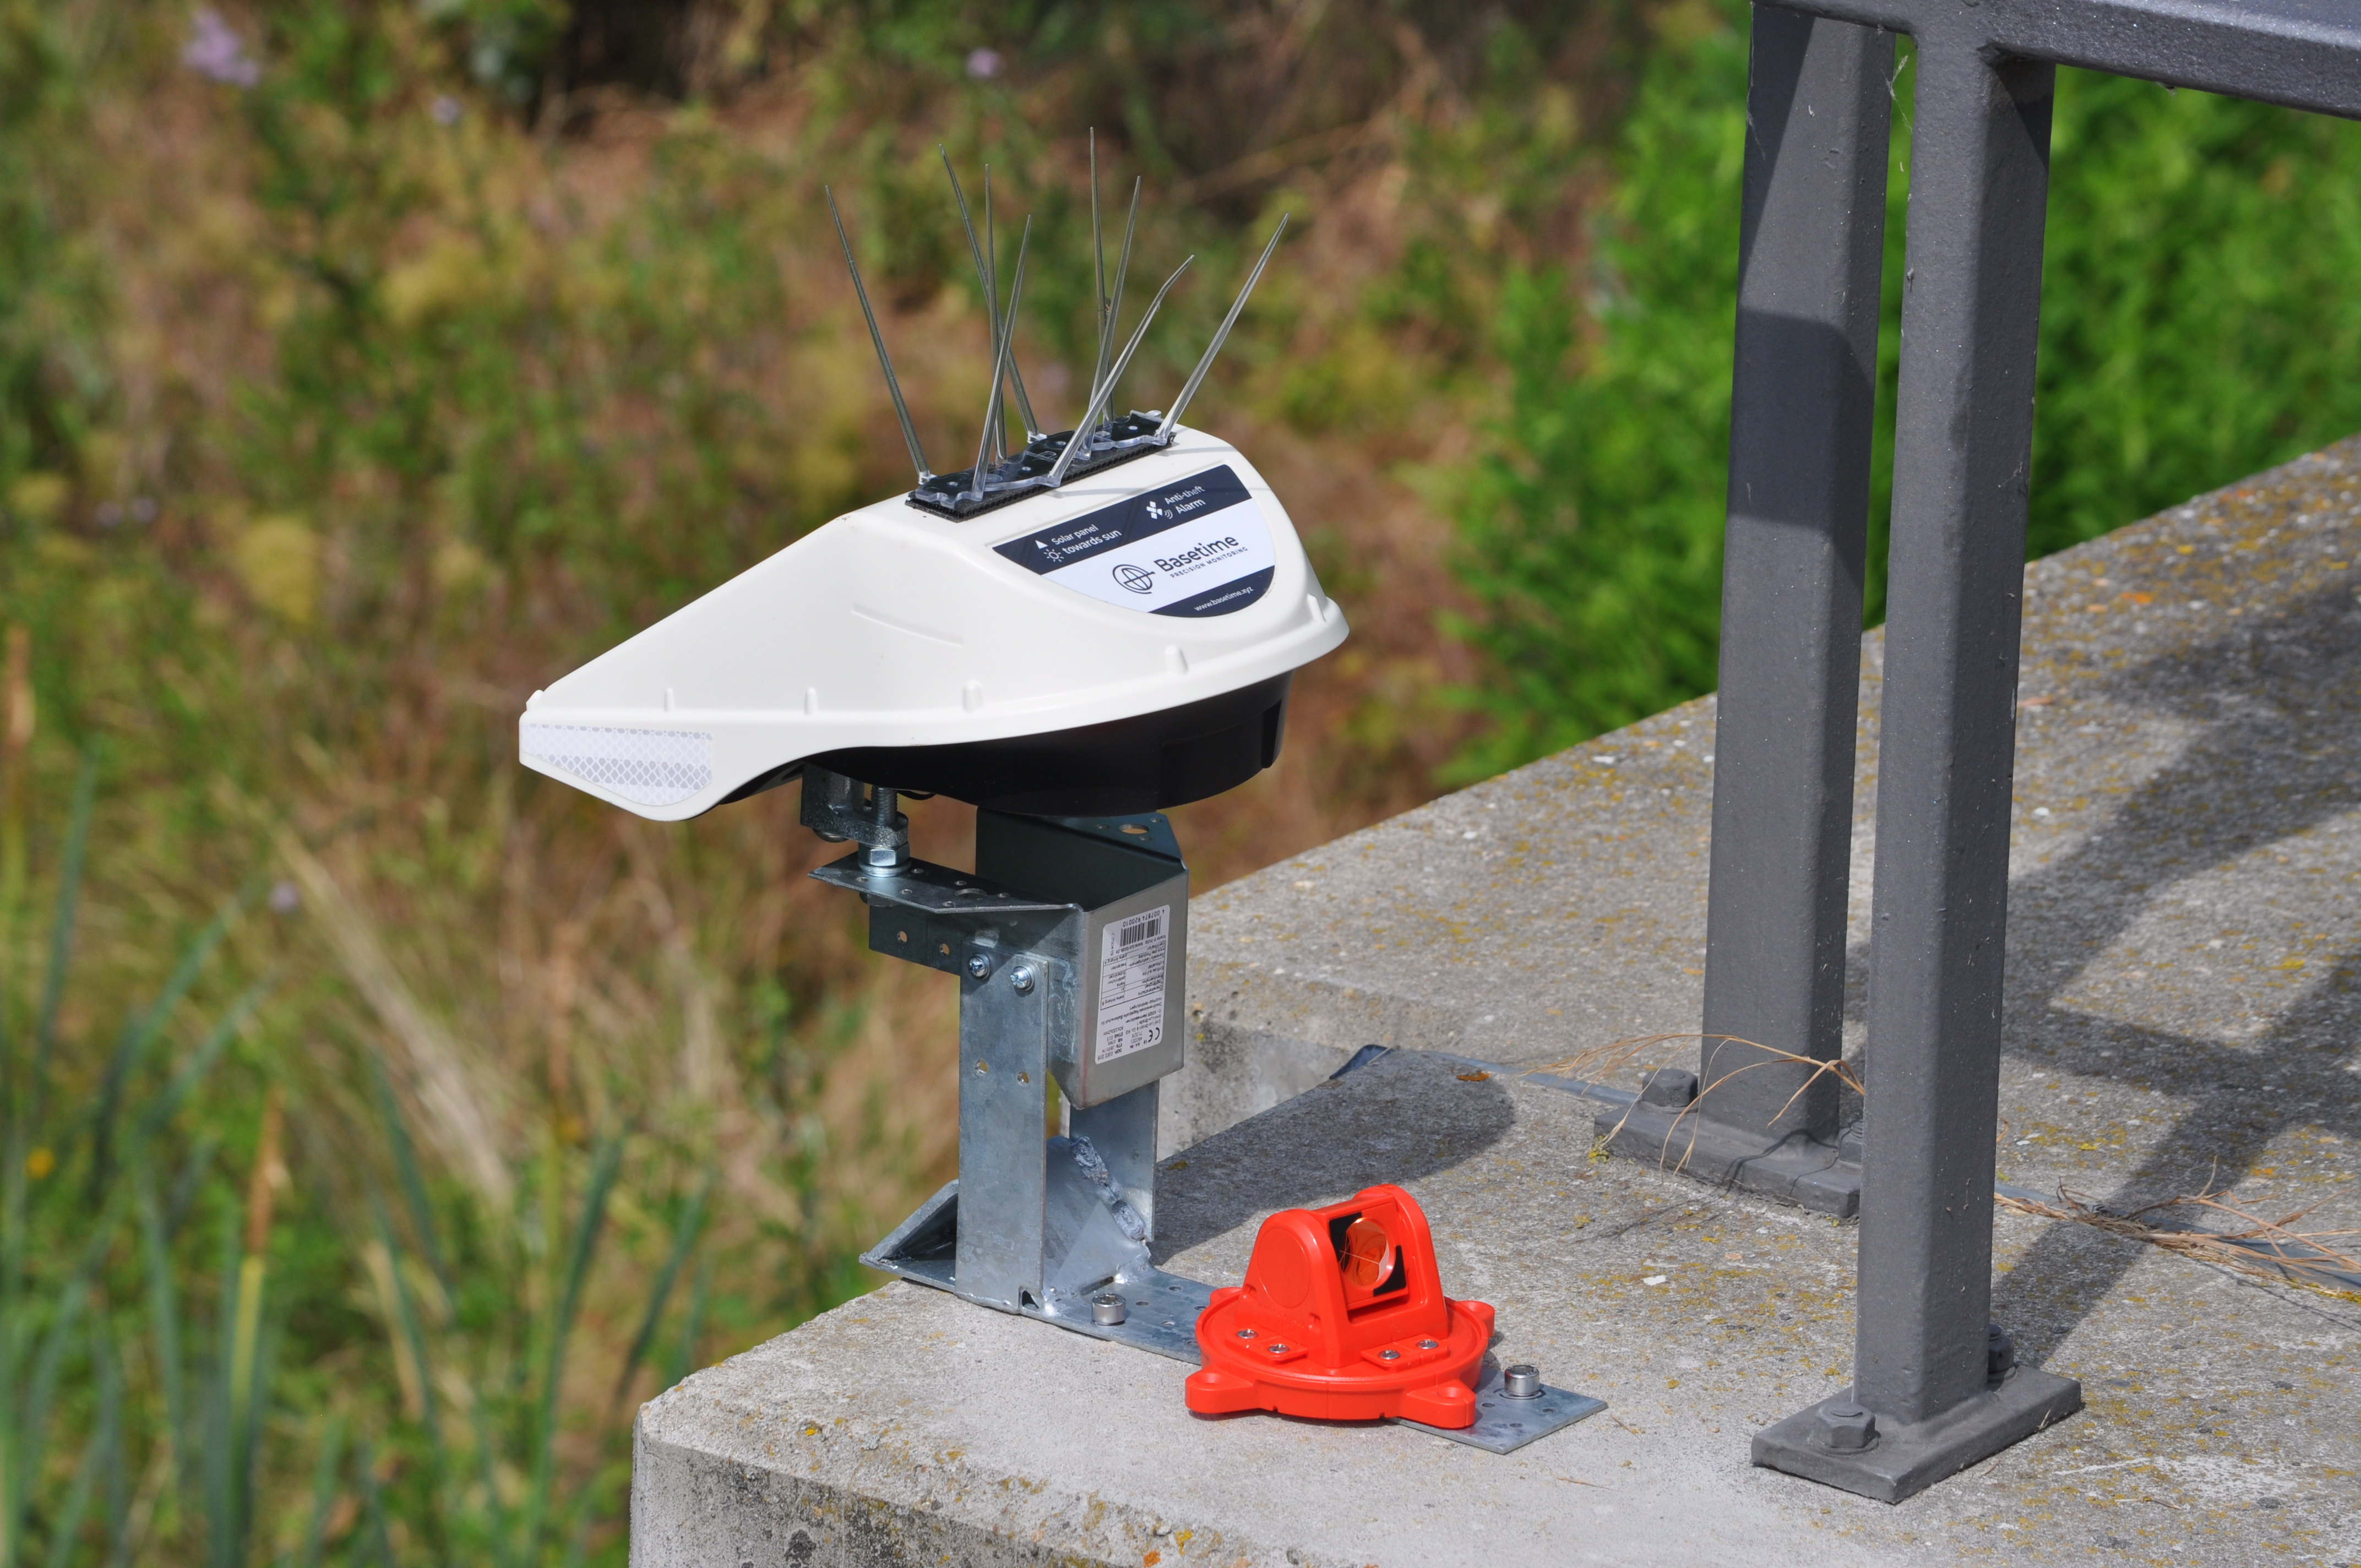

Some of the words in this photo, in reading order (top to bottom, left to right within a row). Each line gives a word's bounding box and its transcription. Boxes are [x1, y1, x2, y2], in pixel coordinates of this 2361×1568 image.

[1165, 486, 1205, 504] Anti-theft
[1175, 499, 1206, 514] Alarm
[1051, 533, 1074, 545] Solar
[1073, 524, 1098, 538] panel
[1062, 537, 1103, 554] towards
[1102, 530, 1122, 541] sun
[1154, 537, 1239, 572] Basetime
[1170, 563, 1206, 578] PRECISION
[1206, 547, 1248, 565] MONITORING
[1194, 586, 1254, 611] www.basetime.xyz
[1123, 917, 1140, 927] 920010
[1142, 910, 1160, 921] 007874
[1148, 1027, 1160, 1042] CE
